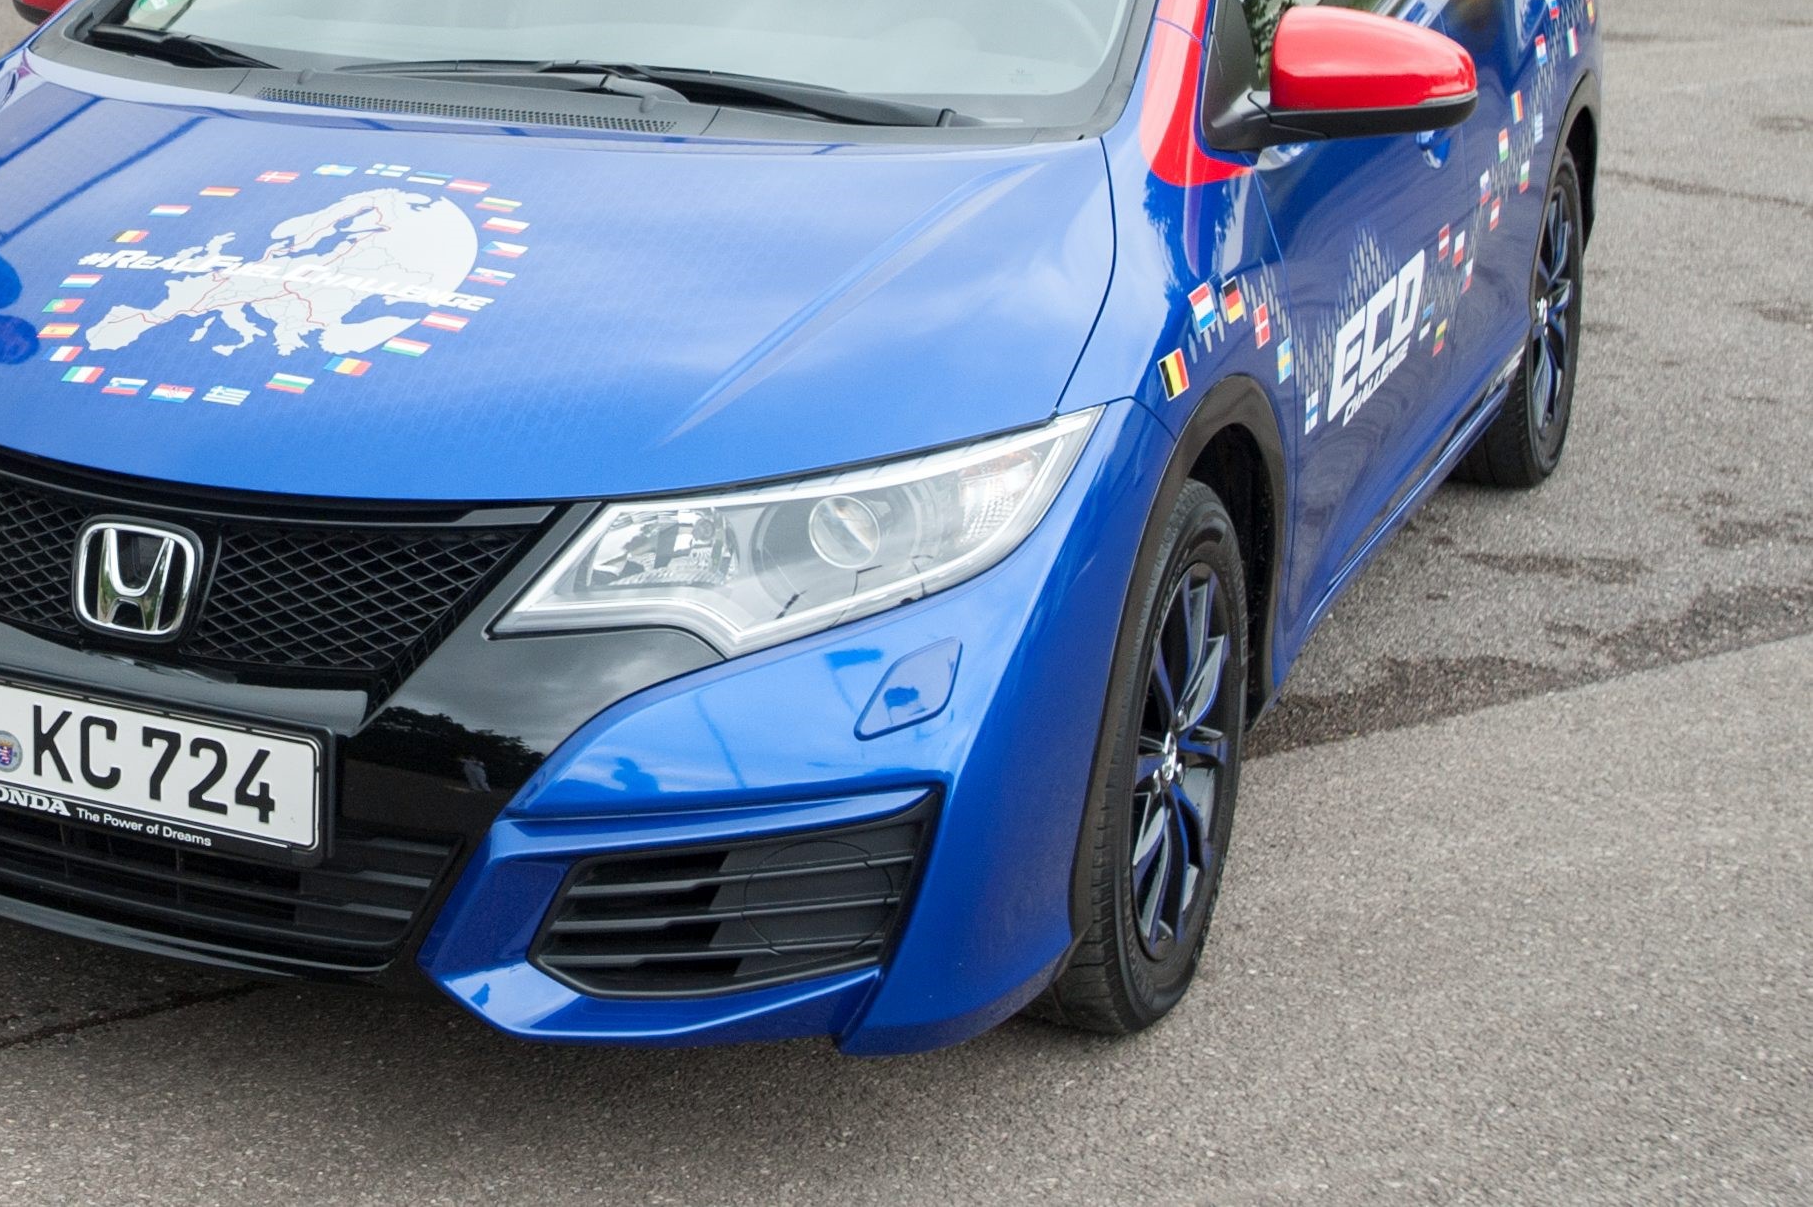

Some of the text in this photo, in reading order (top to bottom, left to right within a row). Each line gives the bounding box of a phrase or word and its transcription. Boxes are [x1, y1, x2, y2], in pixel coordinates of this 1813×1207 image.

[1326, 248, 1426, 423] ECO
[1343, 336, 1410, 427] CHALLENGE
[32, 704, 122, 791] KC
[141, 727, 276, 824] 724
[76, 807, 101, 823] The
[103, 812, 144, 833] Power
[146, 824, 160, 837] of
[162, 827, 212, 847] Dreams
